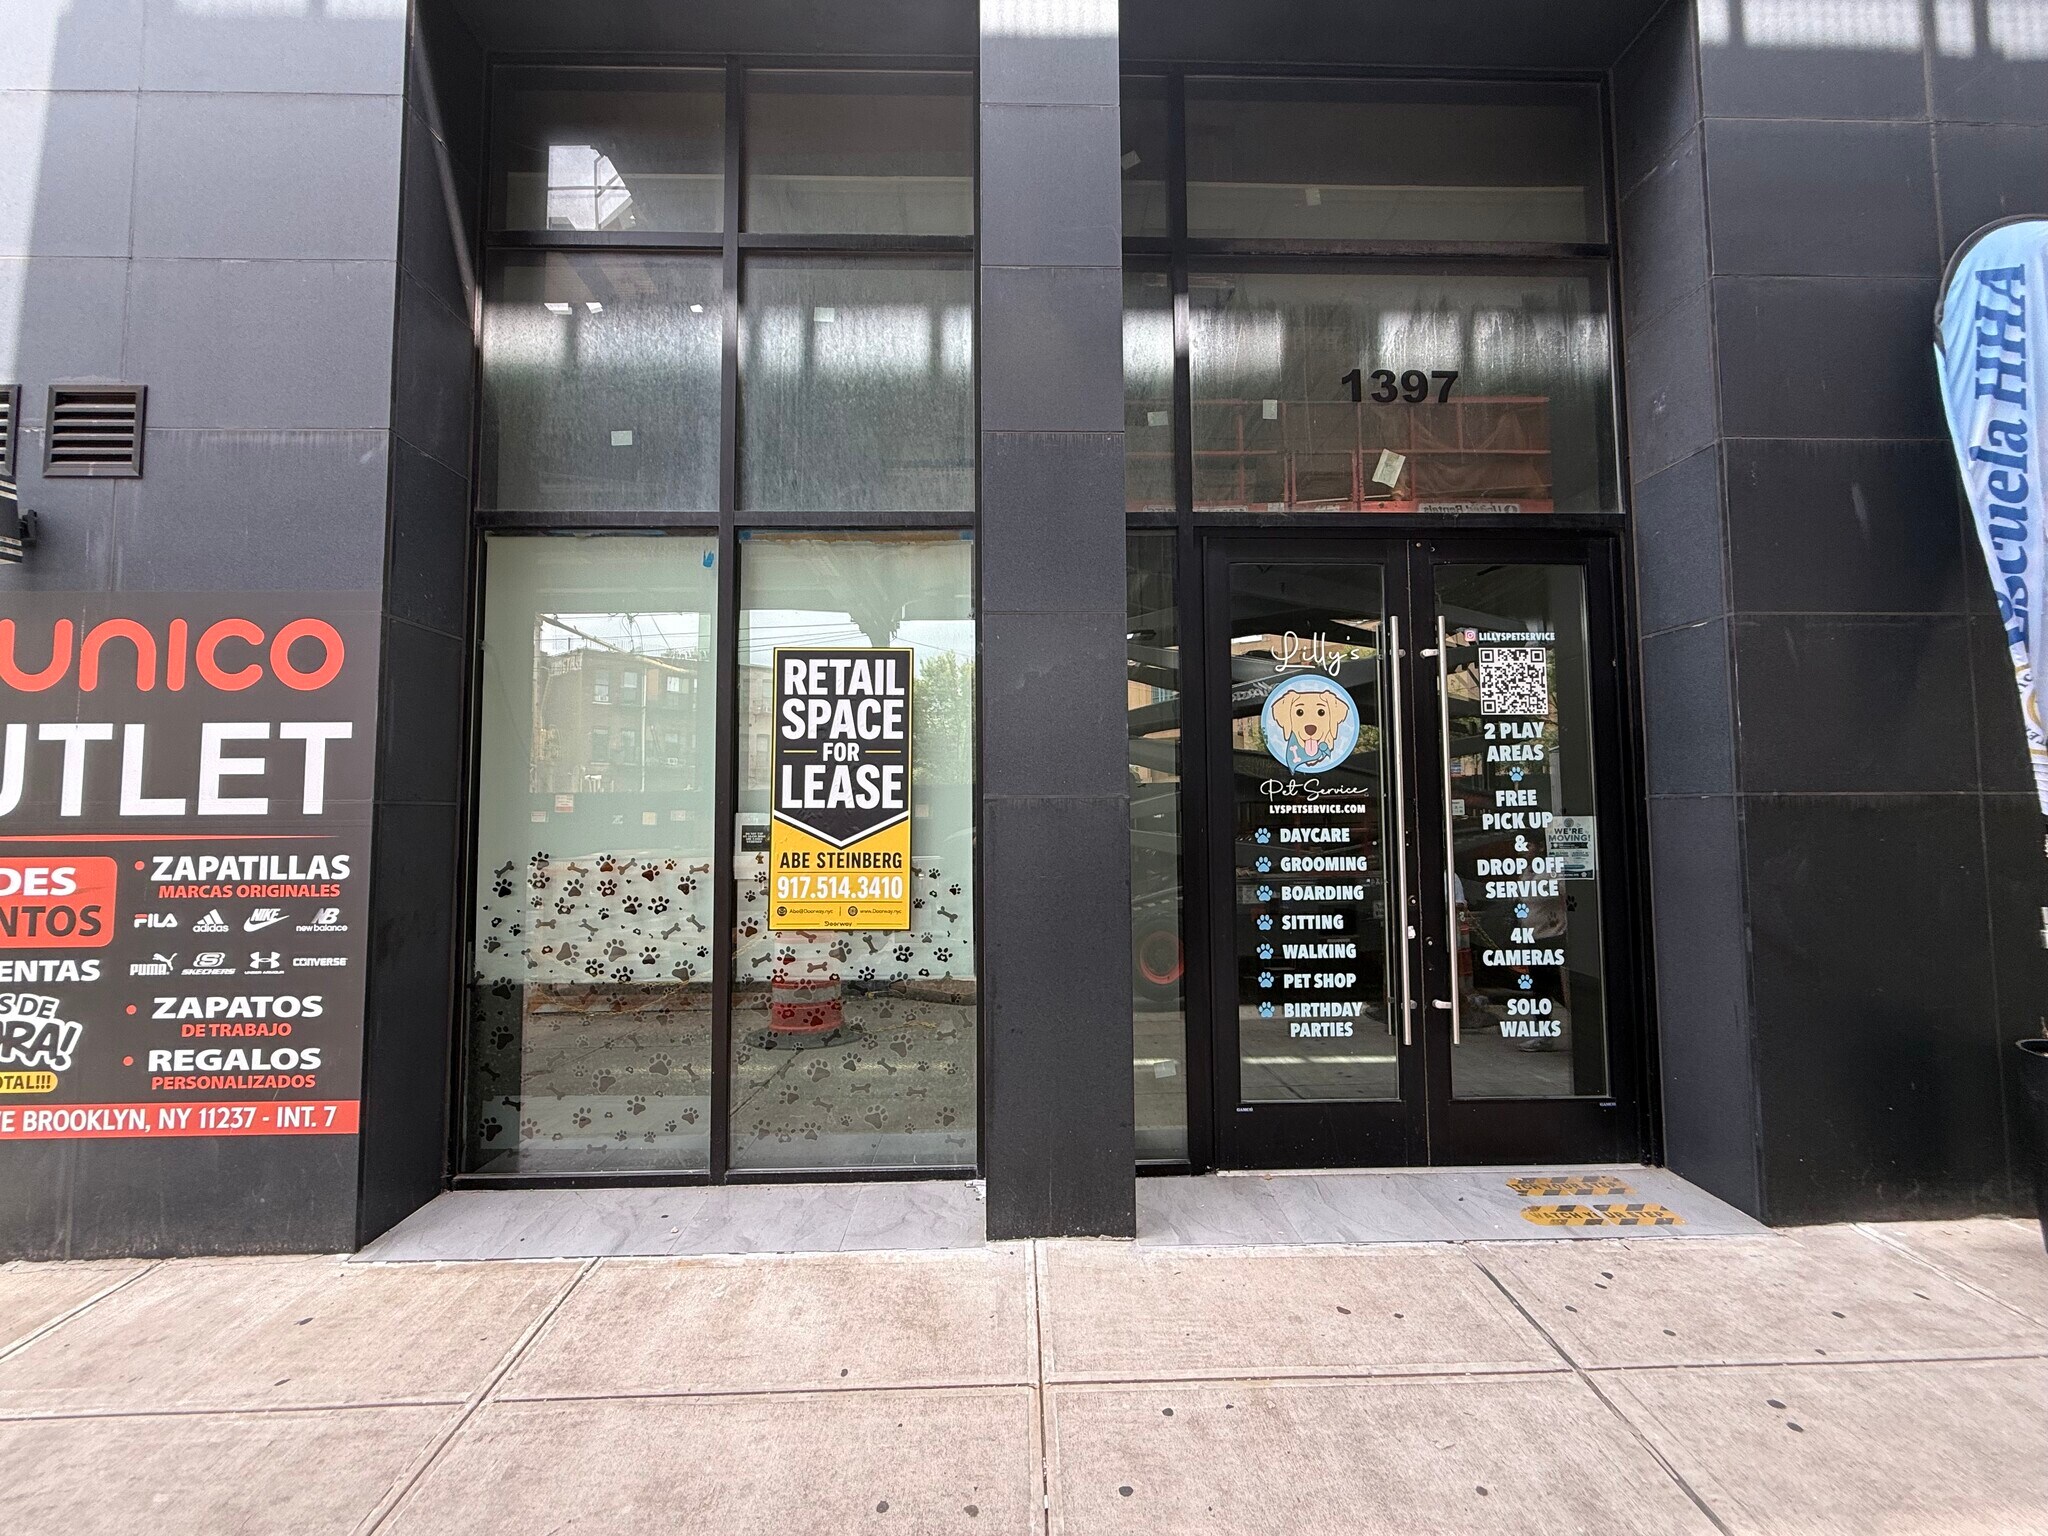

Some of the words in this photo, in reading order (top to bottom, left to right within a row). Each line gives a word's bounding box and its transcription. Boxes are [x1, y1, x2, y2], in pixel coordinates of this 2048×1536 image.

[1975, 264, 2027, 411] HHA
[1341, 369, 1459, 404] 1397
[1478, 632, 1556, 642] LILLYSPETSERVICE
[1271, 630, 1360, 677] Lilly's
[784, 658, 905, 696] RETAIL
[781, 698, 904, 740] SPACE
[1484, 723, 1496, 740] 2
[1500, 721, 1545, 740] PLAY
[822, 742, 860, 762] FOR
[1487, 745, 1545, 762] AREAS
[781, 763, 904, 810] LEASE
[1260, 779, 1303, 801] Pet
[1303, 778, 1368, 801] Service
[1495, 789, 1538, 807] FREE
[1269, 804, 1366, 815] LYSPETSERVICE.COM
[1482, 813, 1526, 831] PICK
[1528, 811, 1553, 829] UP
[1280, 828, 1351, 843] DAYCARE
[1548, 834, 1591, 842] MOVING!
[1554, 827, 1584, 835] WE'RE
[1514, 835, 1529, 852] &
[150, 854, 351, 882] ZAPATILLAS
[780, 852, 811, 869] ABE
[816, 852, 903, 869] STEINBERG
[1280, 856, 1368, 872] GROOMING
[1476, 858, 1528, 876] DROP
[1531, 856, 1564, 874] OFF
[0, 866, 77, 897] DES
[777, 875, 903, 899] 917.514.3410
[1485, 879, 1559, 899] SERVICE
[158, 884, 233, 899] MARCAS
[236, 883, 340, 898] ORIGINALES
[1281, 885, 1364, 901] BOARDING
[0, 905, 102, 937] NTOS
[134, 913, 178, 928] FILA
[251, 908, 281, 922] NIKE
[1281, 914, 1344, 930] SITTING
[192, 924, 230, 933] adidas
[313, 923, 348, 932] balance
[1510, 927, 1535, 944] 4K
[1282, 944, 1357, 959] WALKING
[1482, 949, 1565, 967] CAMERAS
[129, 963, 167, 976] PUMA
[292, 957, 348, 967] CONVERSE
[0, 959, 101, 983] ENTAS
[180, 968, 237, 976] SKECHERS
[1283, 973, 1311, 989] PET
[1313, 973, 1357, 989] SHOP
[18, 996, 56, 1019] DE
[151, 995, 324, 1020] ZAPATOS
[1283, 1002, 1363, 1017] BIRTHDAY
[1506, 998, 1552, 1016] SOLO
[181, 1023, 205, 1038] DE
[208, 1022, 292, 1037] TRABAJO
[1290, 1022, 1354, 1038] PARTIES
[1499, 1020, 1562, 1038] WALKS
[0, 1020, 78, 1067] RA!
[147, 1047, 322, 1072] REGALOS
[0, 1074, 51, 1090] TAL!!!
[151, 1074, 316, 1090] PERSONALIZADOS
[0, 1110, 15, 1132] E
[22, 1108, 151, 1133] BROOKLYN,
[158, 1107, 193, 1130] NY
[198, 1106, 257, 1129] 11237
[276, 1106, 317, 1128] INT.
[323, 1105, 337, 1127] 7
[1529, 1211, 1583, 1219] WATCH
